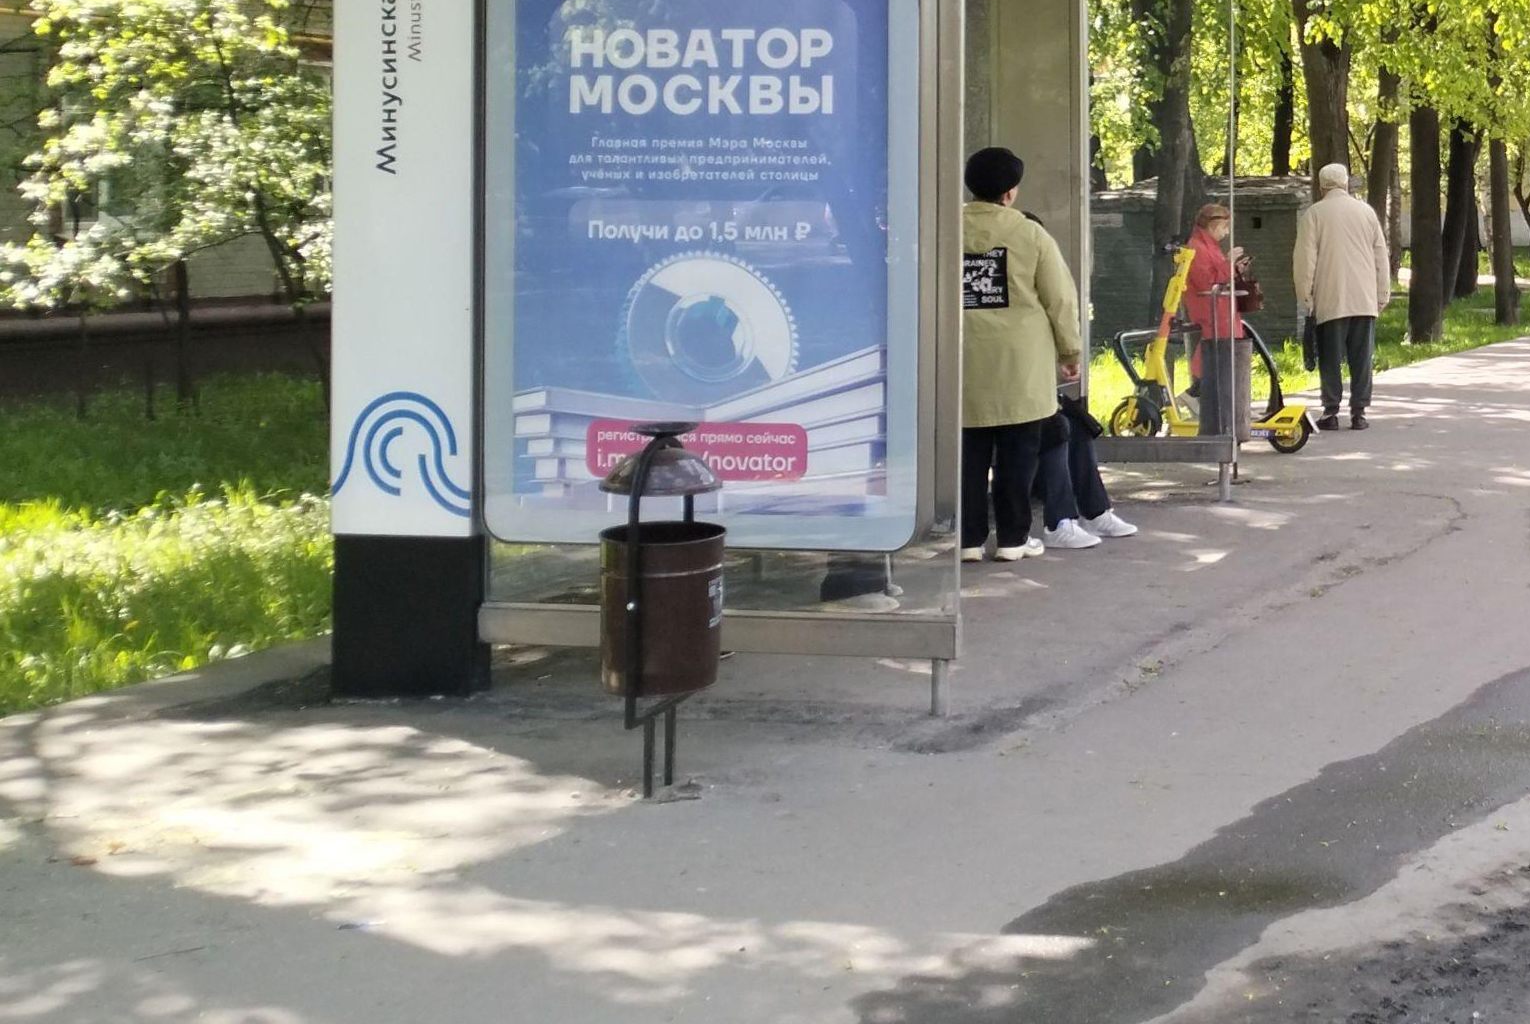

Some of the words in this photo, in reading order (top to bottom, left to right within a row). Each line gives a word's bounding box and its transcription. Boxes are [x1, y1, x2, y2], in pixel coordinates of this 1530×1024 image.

[568, 28, 834, 69] НОВАТОР
[568, 74, 834, 115] МОСКВЫ
[591, 136, 647, 149] Главная
[652, 138, 704, 151] премия
[708, 136, 748, 151] Мэра
[753, 136, 808, 149] Москвы
[568, 154, 593, 165] для
[597, 154, 683, 165] талантливых
[635, 170, 645, 180] и
[648, 167, 755, 182] изобретателей
[760, 169, 820, 181] столицы
[588, 220, 669, 244] Получи
[674, 224, 704, 242] до
[710, 221, 738, 243] 1,5
[745, 225, 788, 241] млн
[794, 221, 811, 241] ₽
[700, 433, 743, 445] прямо
[746, 431, 797, 445] сейчас
